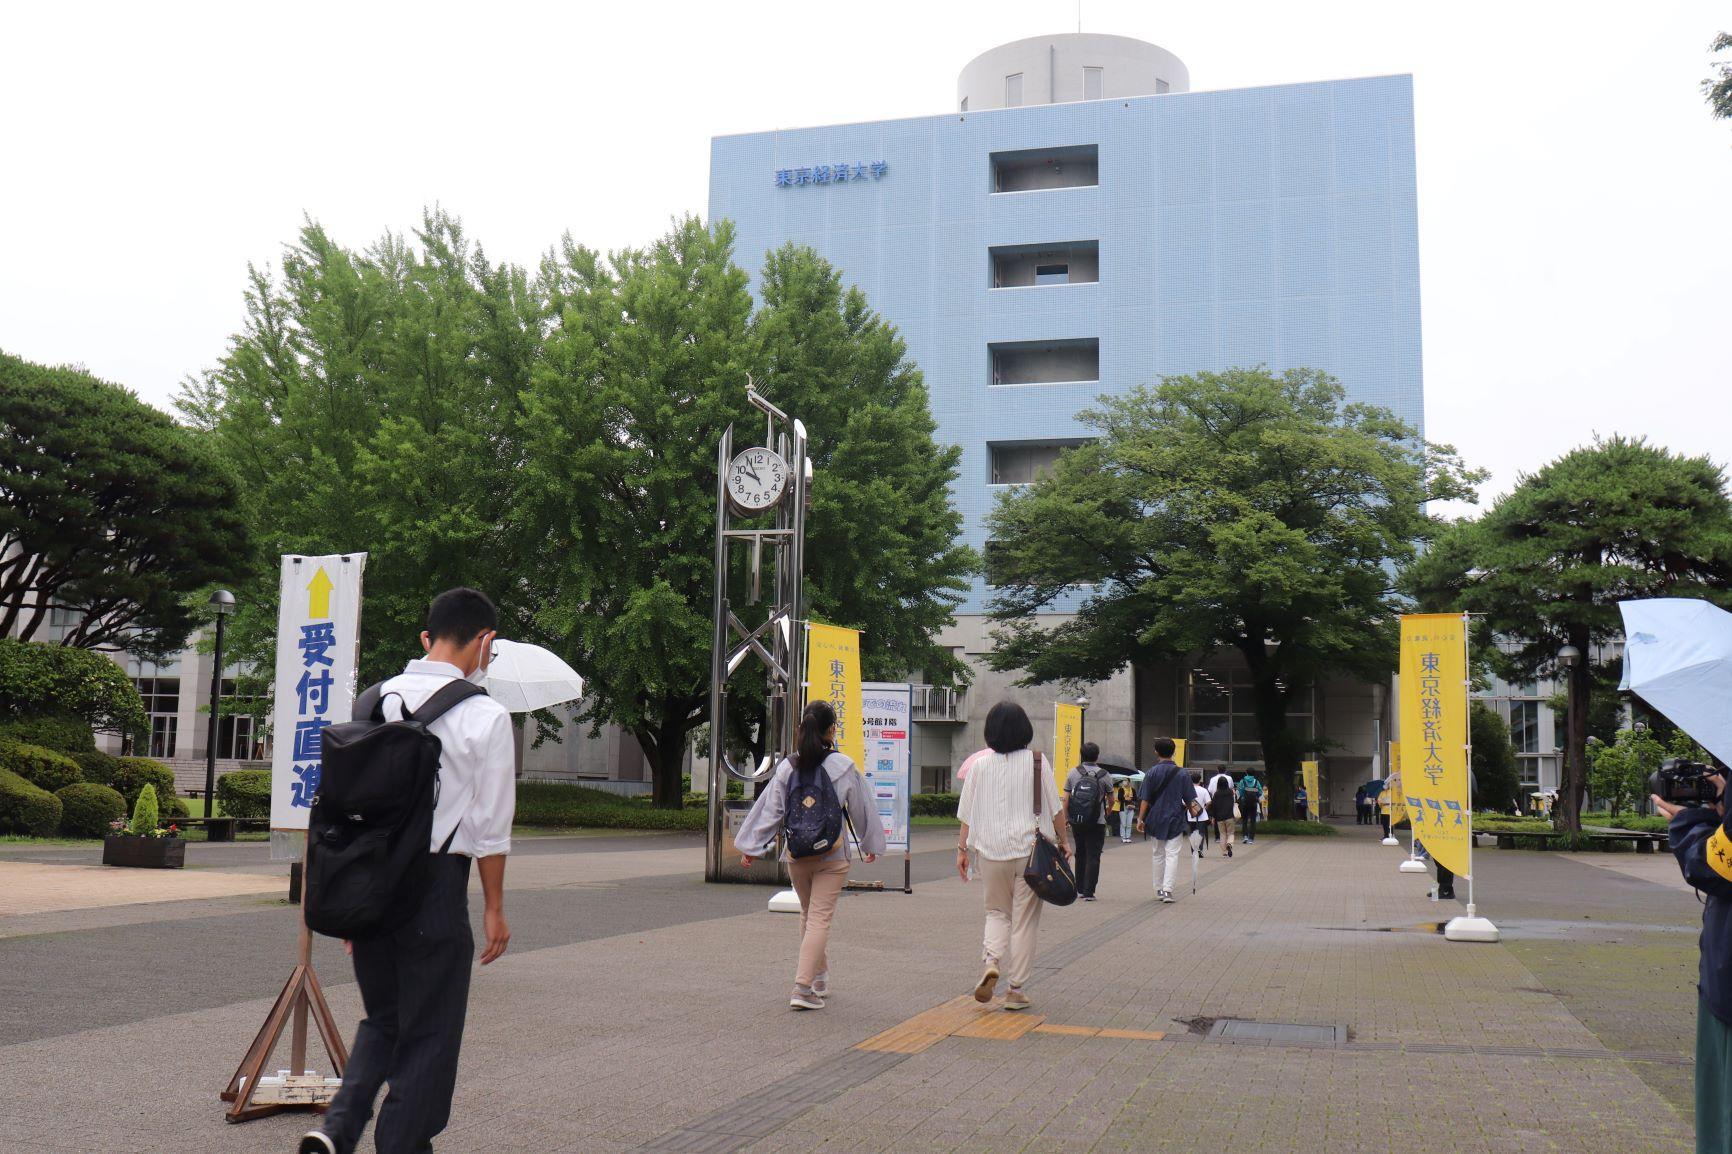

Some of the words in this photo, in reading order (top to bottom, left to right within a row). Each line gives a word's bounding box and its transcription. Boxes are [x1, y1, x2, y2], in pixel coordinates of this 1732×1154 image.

[775, 160, 888, 187] 東京経済大学
[754, 455, 763, 464] 12
[736, 466, 746, 474] 10
[772, 463, 778, 472] 2
[735, 476, 741, 484] 9
[774, 474, 780, 482] 3
[738, 485, 744, 493] 8
[771, 483, 777, 492] 4
[745, 492, 751, 500] 7
[754, 494, 760, 502] 6
[764, 491, 770, 500] 5
[291, 622, 336, 808] 受付直進
